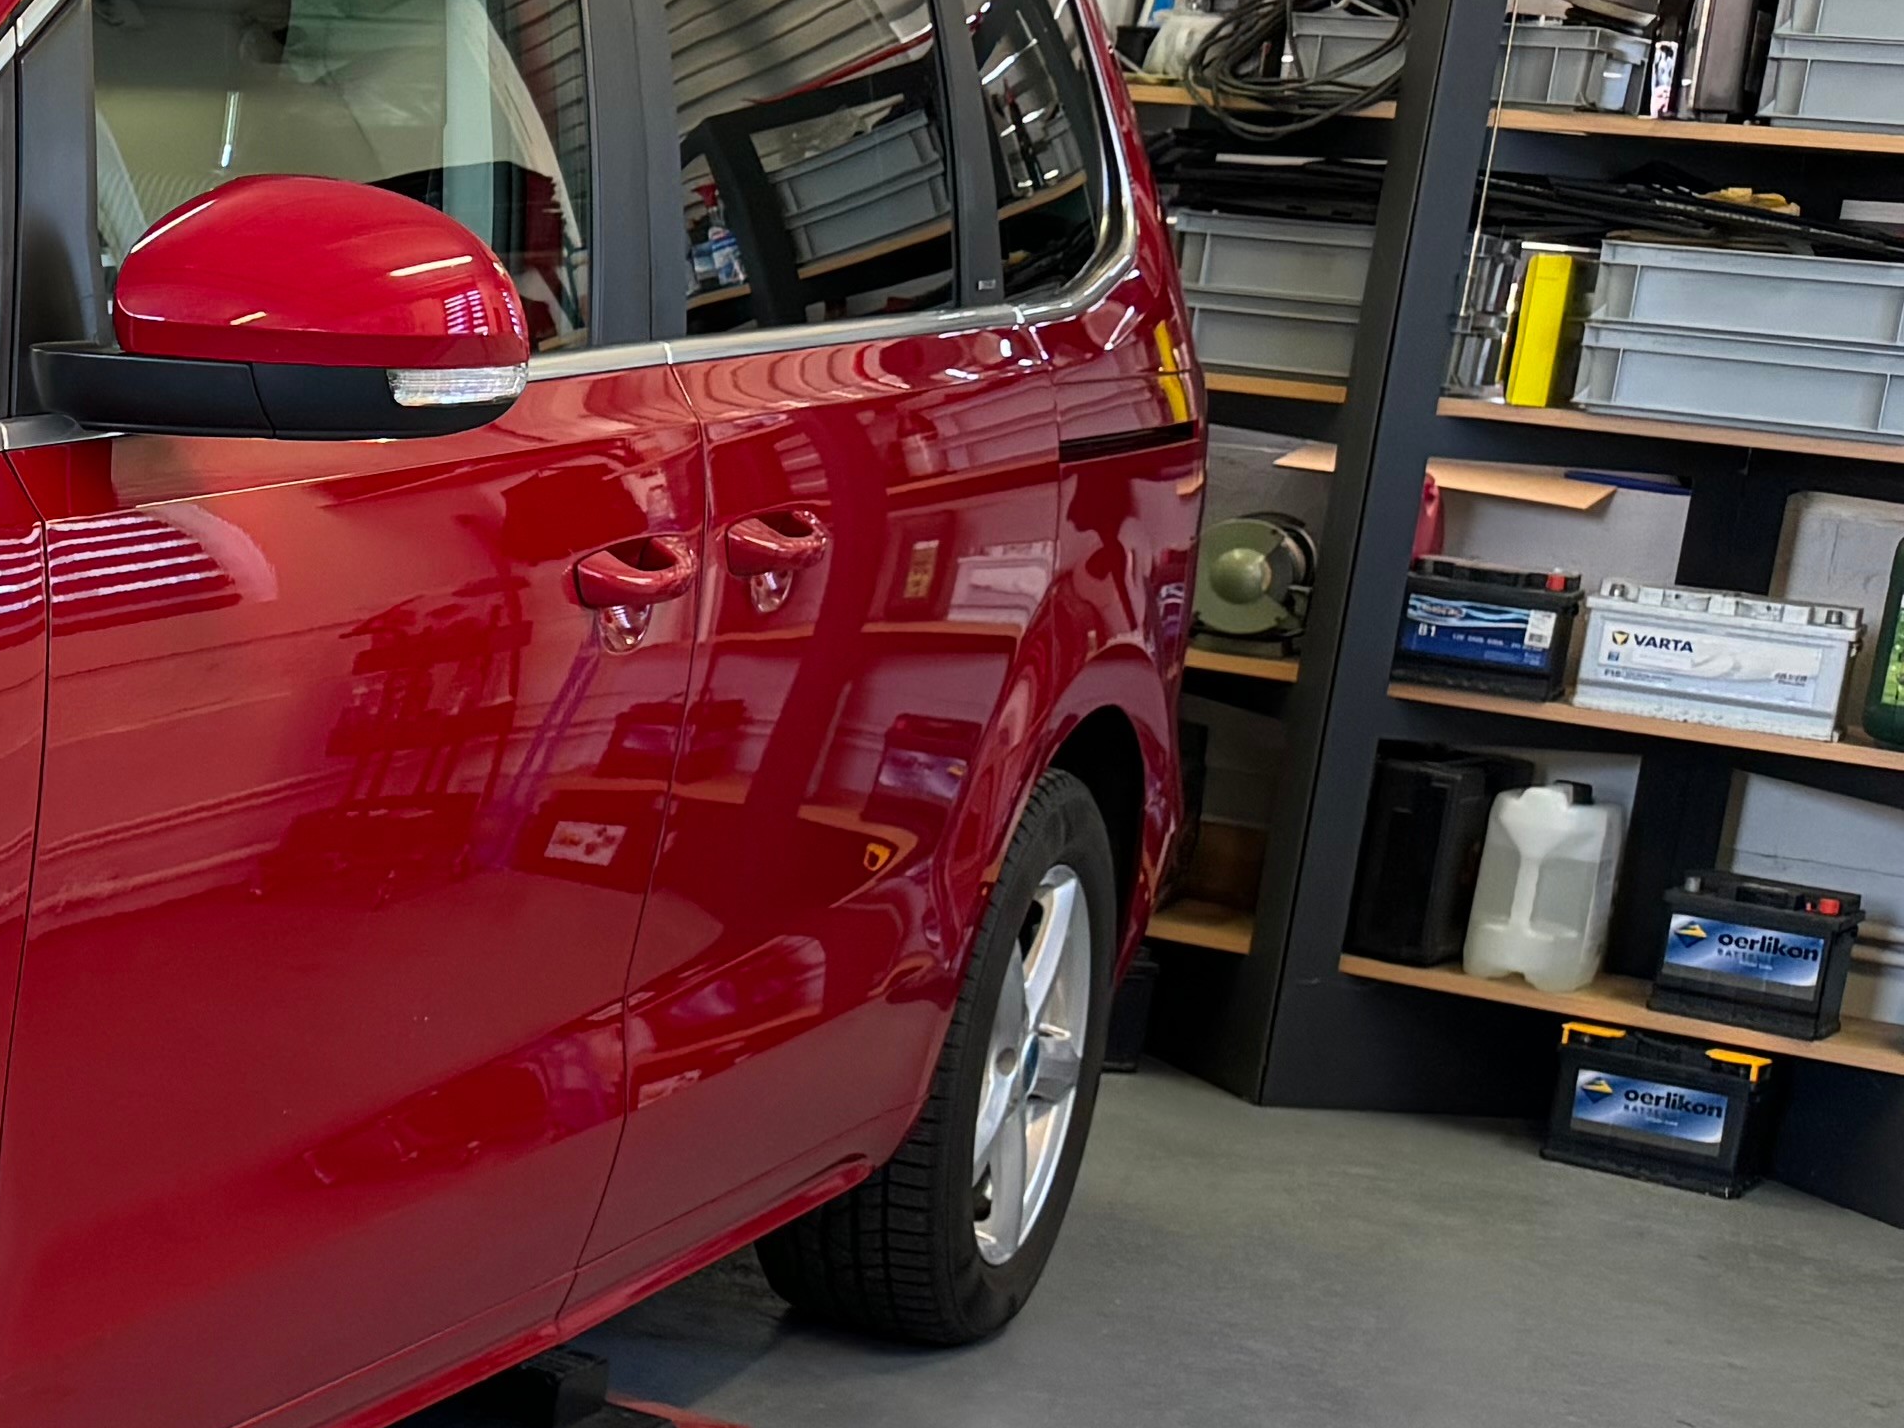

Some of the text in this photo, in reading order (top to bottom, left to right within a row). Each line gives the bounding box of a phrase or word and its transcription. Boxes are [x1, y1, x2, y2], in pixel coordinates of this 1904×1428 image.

[1633, 633, 1694, 653] VARTA
[1718, 933, 1819, 962] oerlikon
[1624, 1089, 1723, 1119] oerlikon
